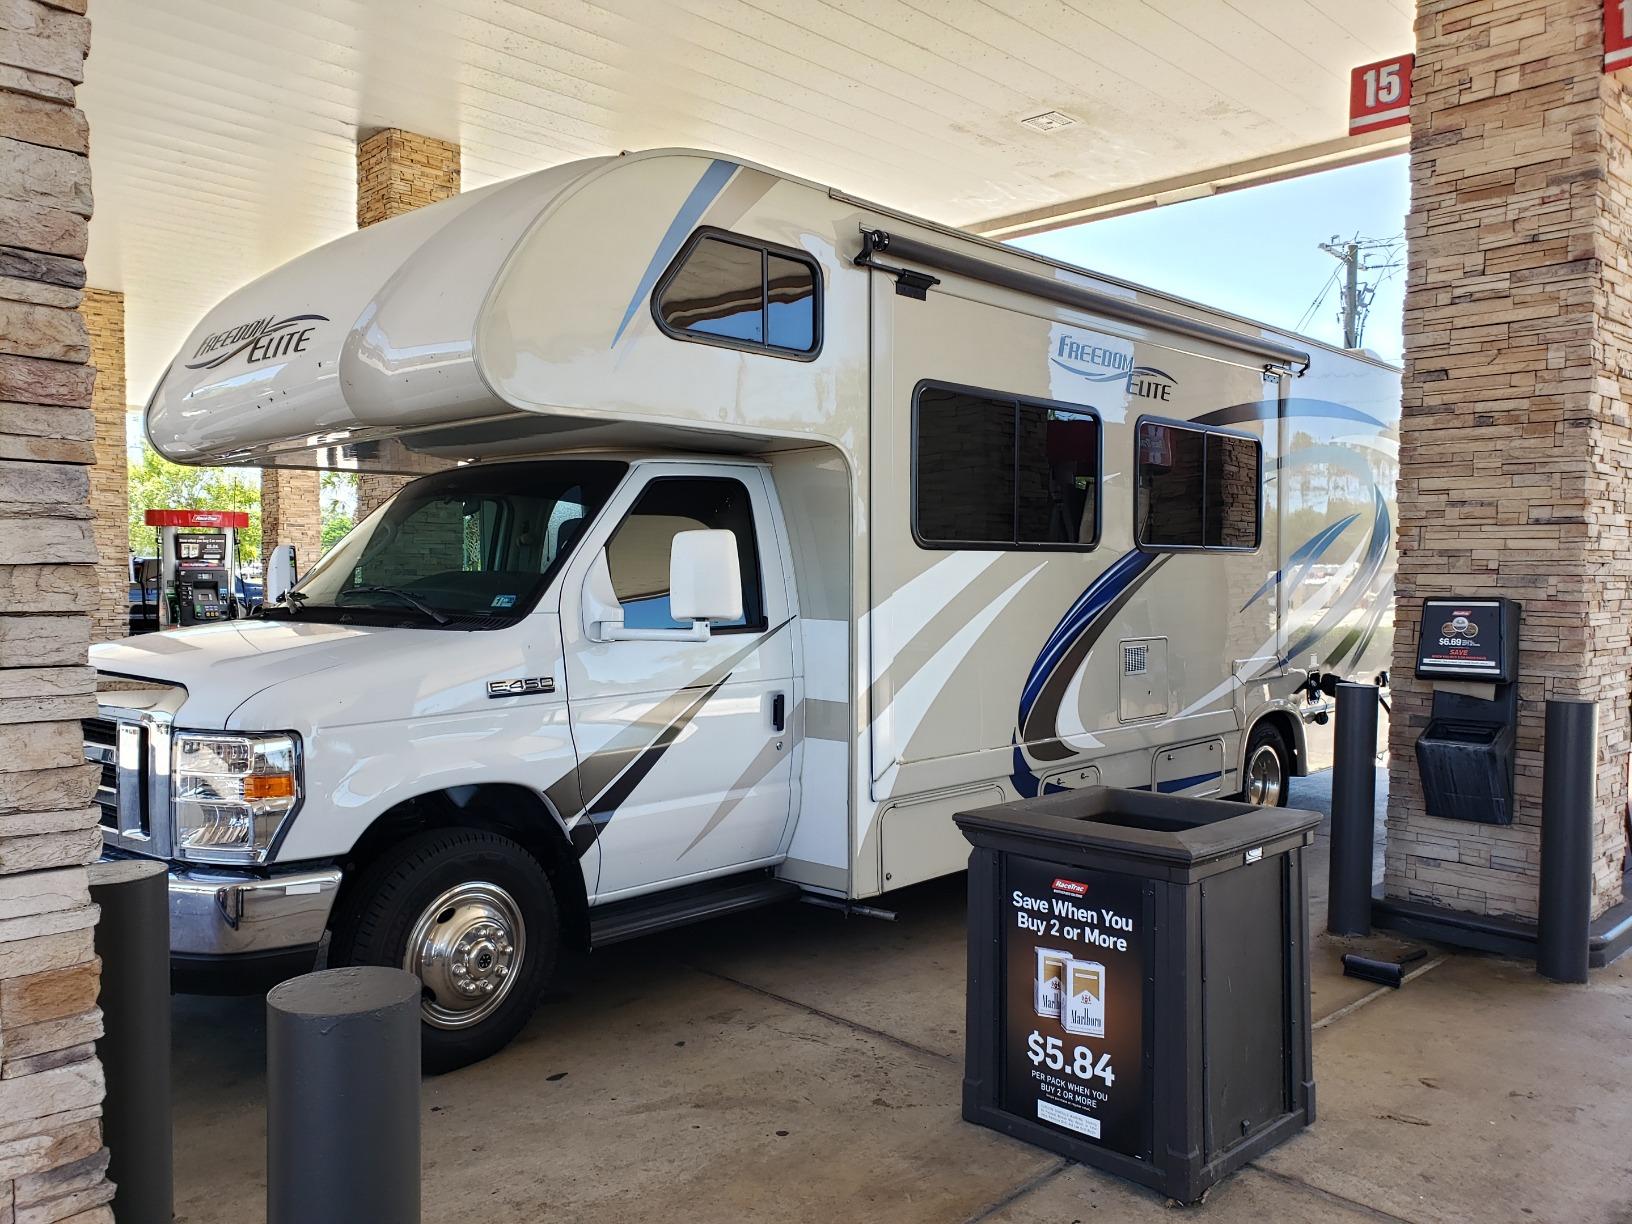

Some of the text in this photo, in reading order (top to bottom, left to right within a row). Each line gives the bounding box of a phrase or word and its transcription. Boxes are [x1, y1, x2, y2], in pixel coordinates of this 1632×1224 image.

[1363, 63, 1401, 108] 15
[193, 315, 276, 359] FREEDOM
[247, 327, 316, 364] ELITE
[1058, 333, 1135, 374] FREEDOM
[1126, 374, 1172, 402] ELITE
[1439, 637, 1462, 646] $6.69
[489, 677, 554, 692] E-450
[1055, 880, 1085, 892] RaceTrac
[1012, 890, 1049, 913] Save
[1052, 898, 1098, 925] When
[1101, 908, 1133, 932] You
[1017, 911, 1128, 952] Buy 2 or More
[1027, 1030, 1115, 1087] $5.84
[1031, 1069, 1108, 1101] PER PACK WHEN YOU
[1040, 1082, 1055, 1094] BUY
[1056, 1088, 1062, 1097] 2
[1062, 1090, 1074, 1101] OR
[1075, 1095, 1098, 1109] MORE
